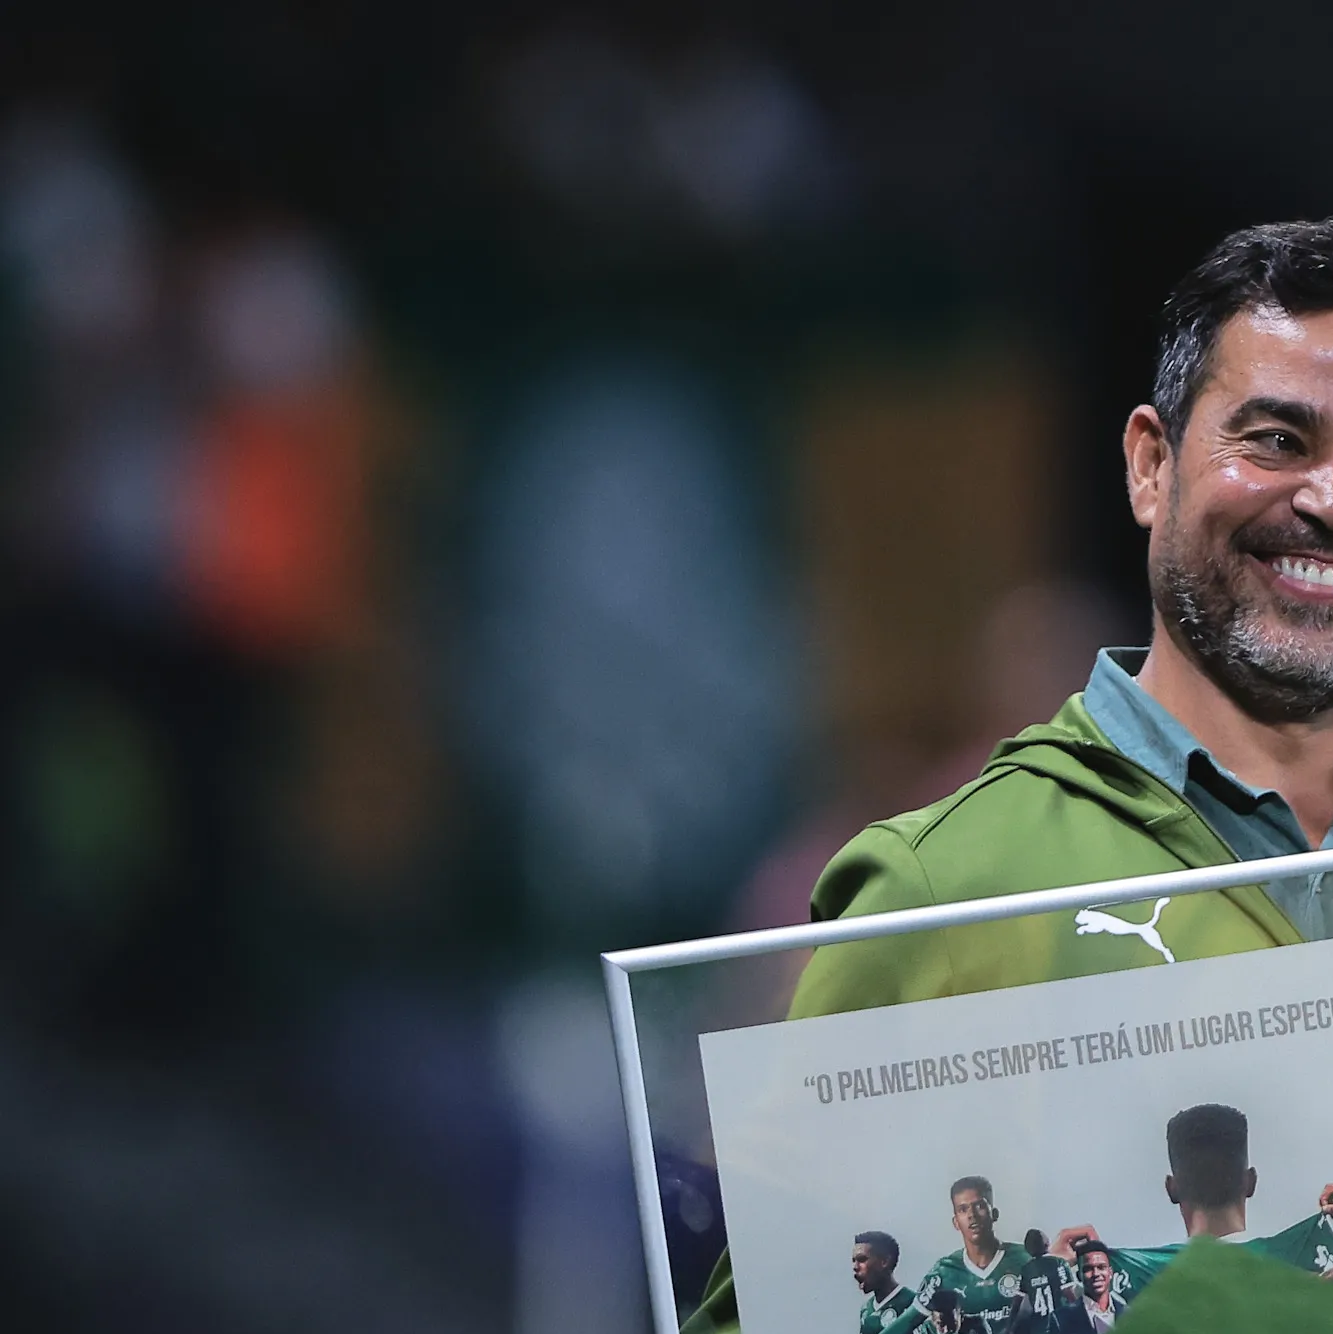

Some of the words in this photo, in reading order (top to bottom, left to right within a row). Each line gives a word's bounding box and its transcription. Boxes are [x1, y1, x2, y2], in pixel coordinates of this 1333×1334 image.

[836, 1052, 969, 1102] PALMEIRAS
[971, 1037, 1069, 1082] SEMPRE
[1069, 1021, 1134, 1066] TERÁ
[1135, 1021, 1175, 1057] UM
[1177, 1010, 1256, 1050] LUGAR
[1034, 1284, 1055, 1317] 41
